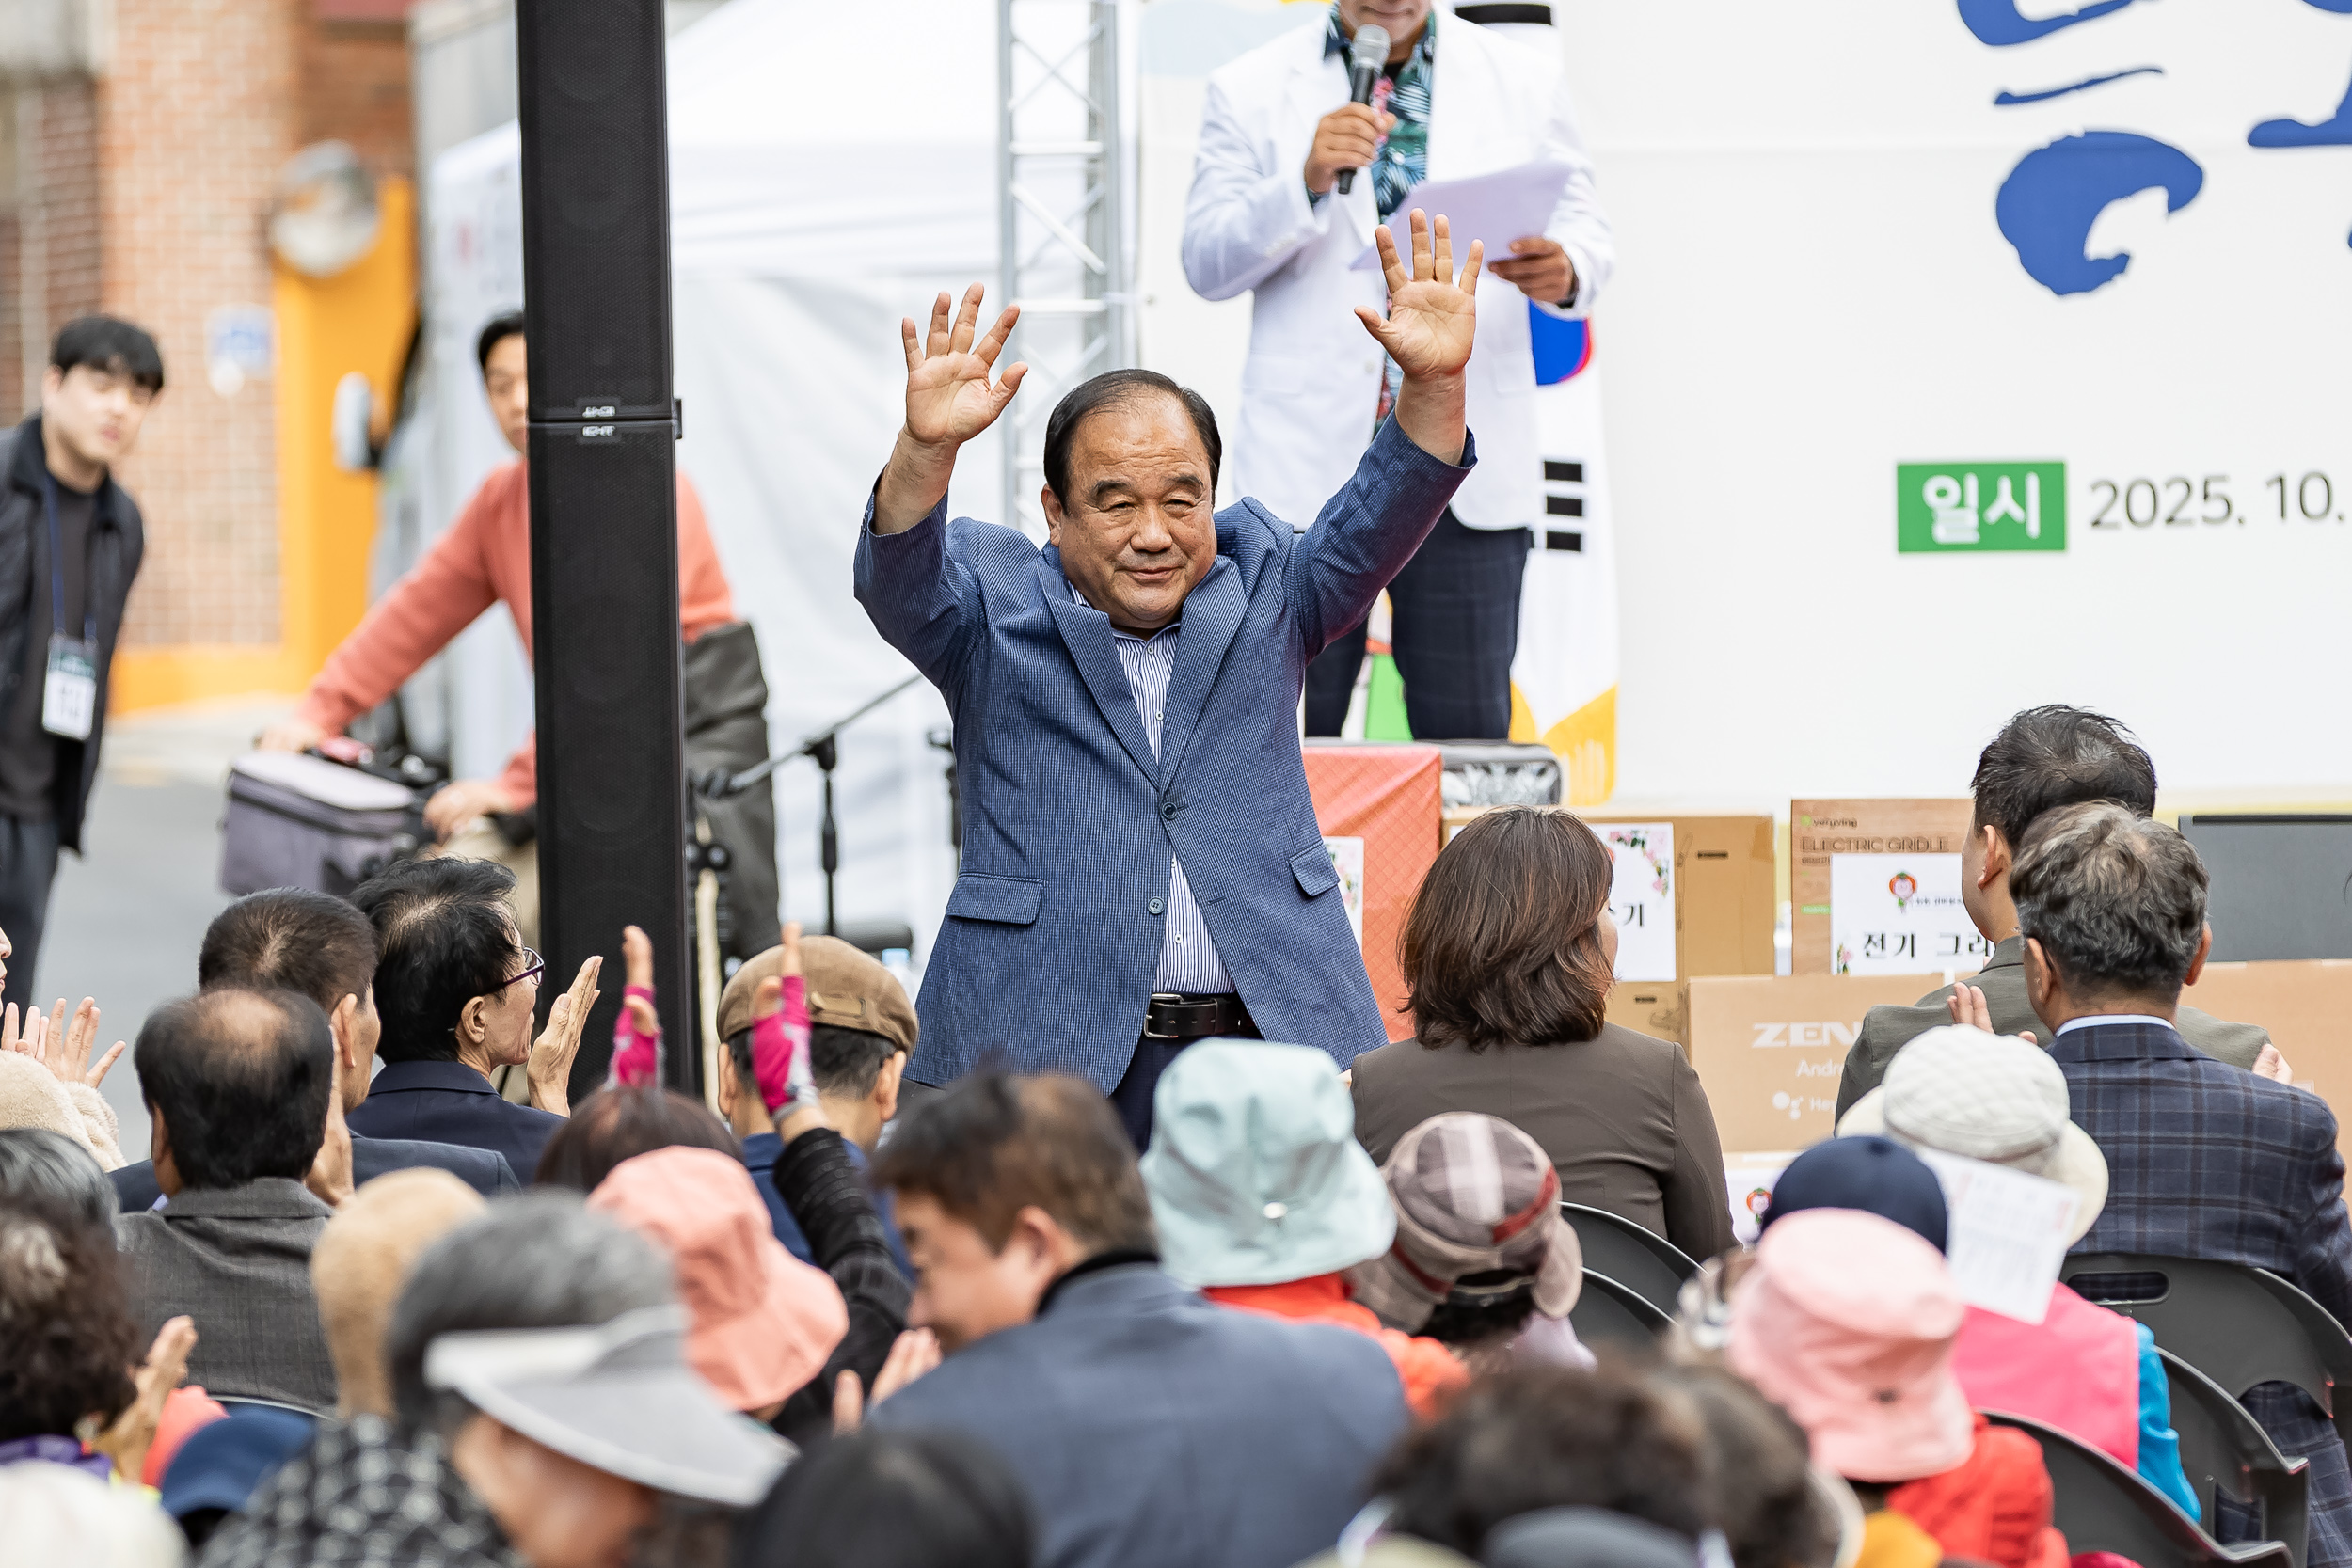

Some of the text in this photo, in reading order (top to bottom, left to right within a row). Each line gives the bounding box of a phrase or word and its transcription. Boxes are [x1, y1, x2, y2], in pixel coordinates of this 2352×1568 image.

[1921, 471, 2345, 545] 일시 2025. 10.
[1801, 836, 1950, 853] ELECTRIC GRIDLE
[1622, 902, 1645, 927] 기
[1863, 931, 1991, 959] 전기 그리
[1752, 1021, 1864, 1049] ZEN
